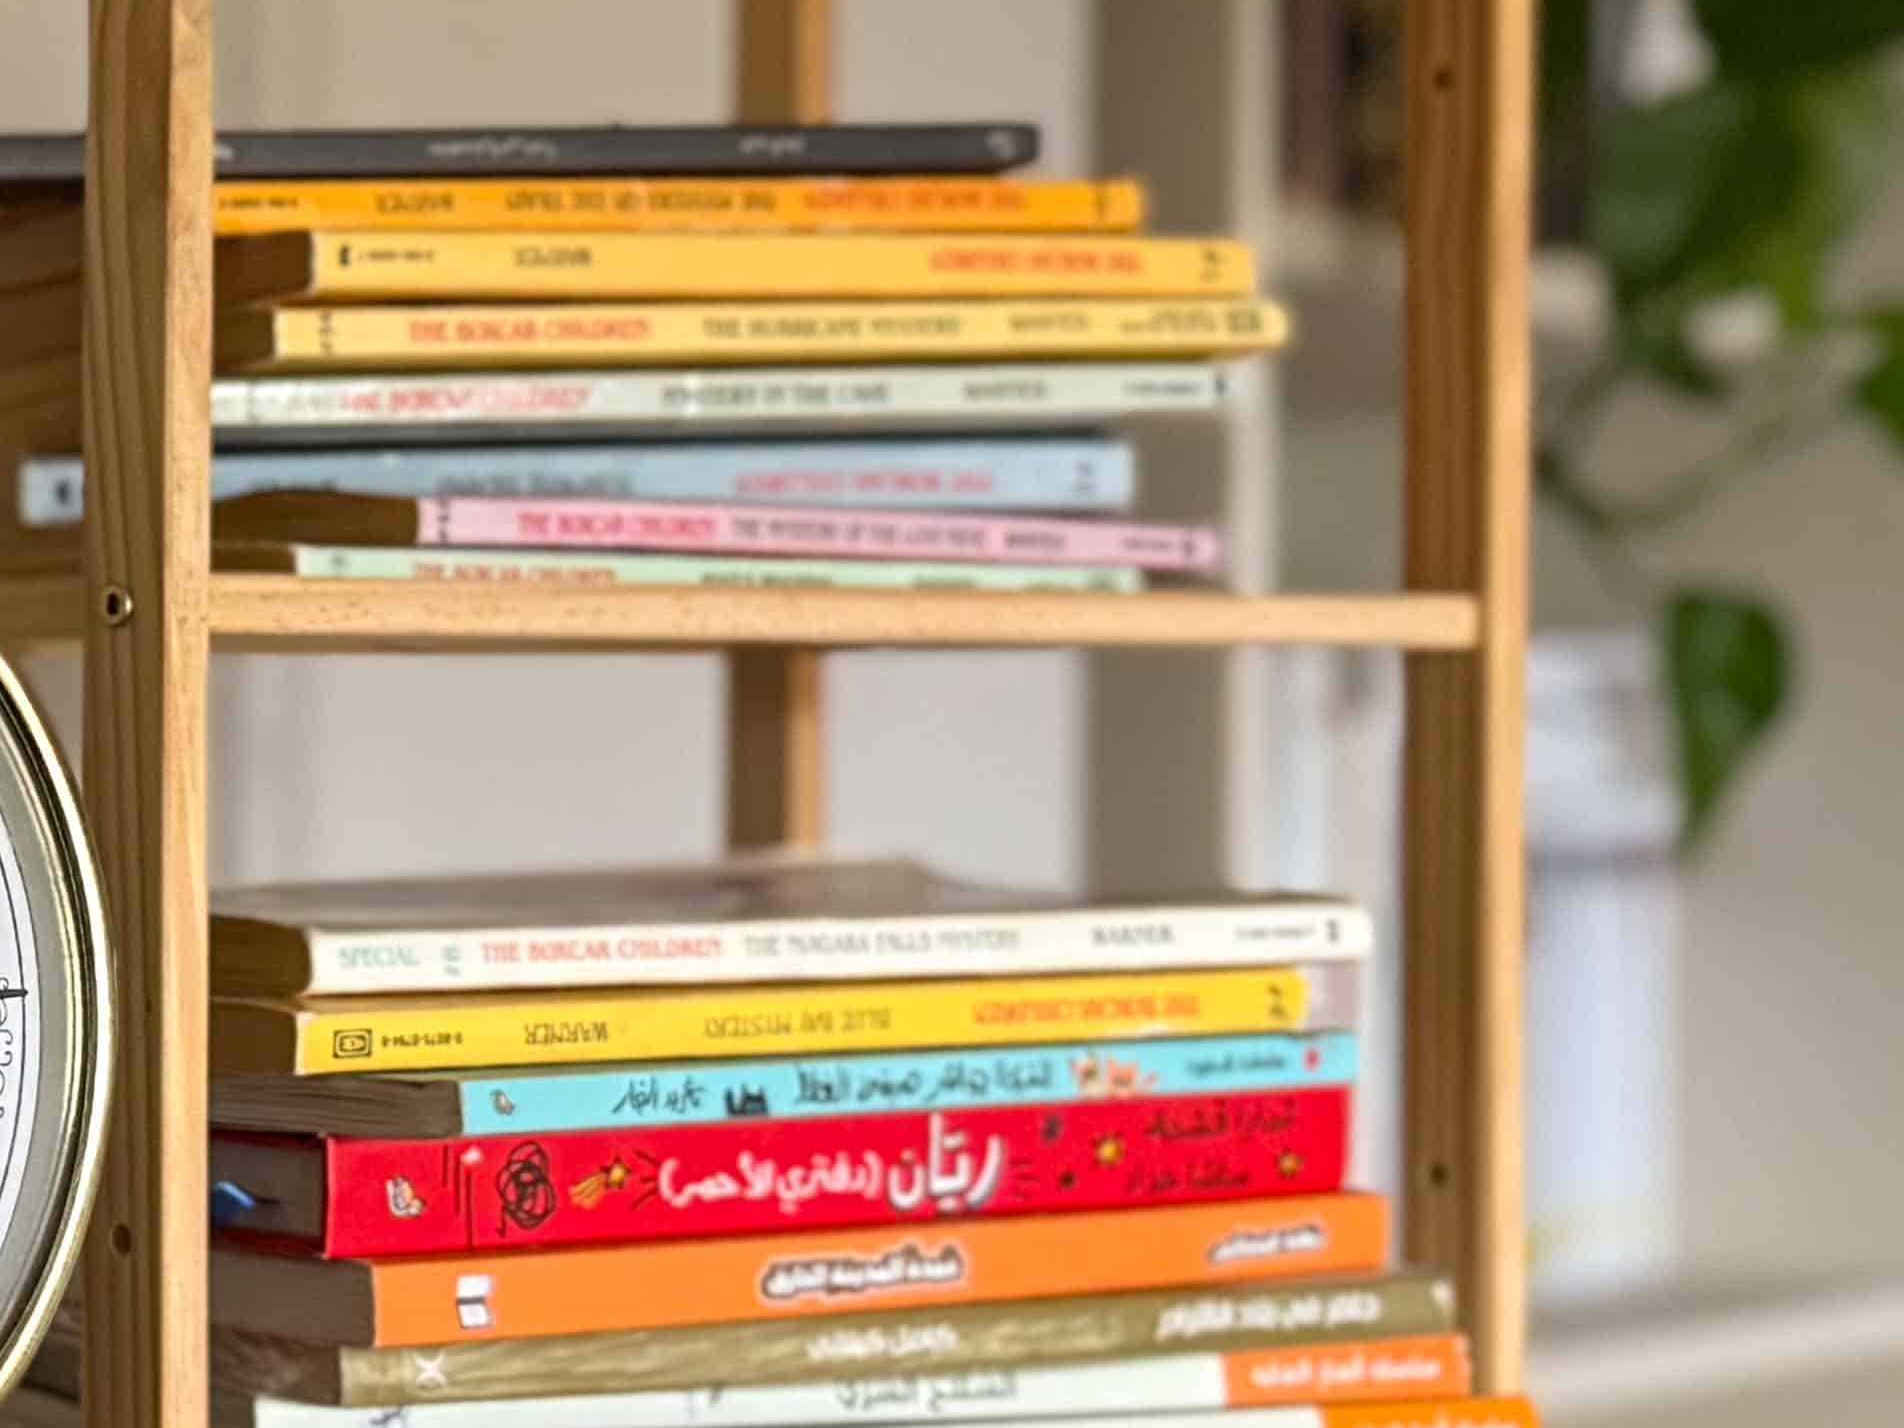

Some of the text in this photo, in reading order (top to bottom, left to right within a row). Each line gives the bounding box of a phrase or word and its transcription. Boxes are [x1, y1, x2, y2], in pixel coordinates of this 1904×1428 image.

[337, 945, 421, 969] SPECIAL
[481, 941, 521, 964] THE
[527, 940, 610, 963] BOXCAR
[616, 936, 724, 961] CHILDREN
[523, 1021, 609, 1046] WARNER
